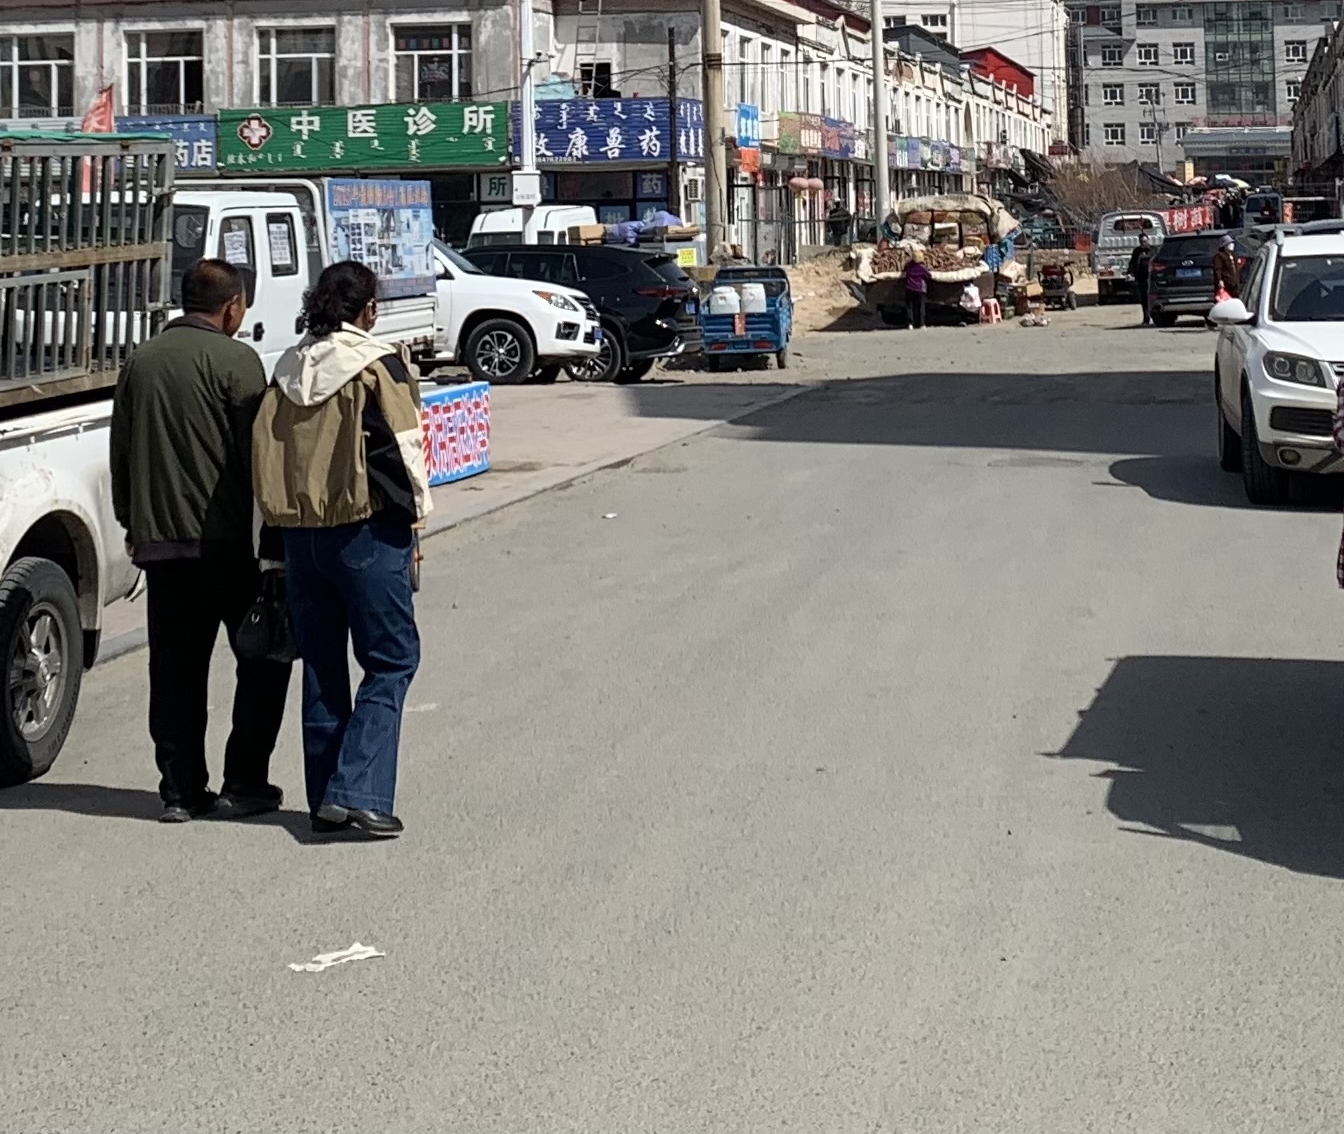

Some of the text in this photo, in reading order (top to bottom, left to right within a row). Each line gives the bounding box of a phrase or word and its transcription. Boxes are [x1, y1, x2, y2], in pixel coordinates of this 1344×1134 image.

[291, 105, 495, 140] 中医诊所
[488, 176, 508, 197] 所
